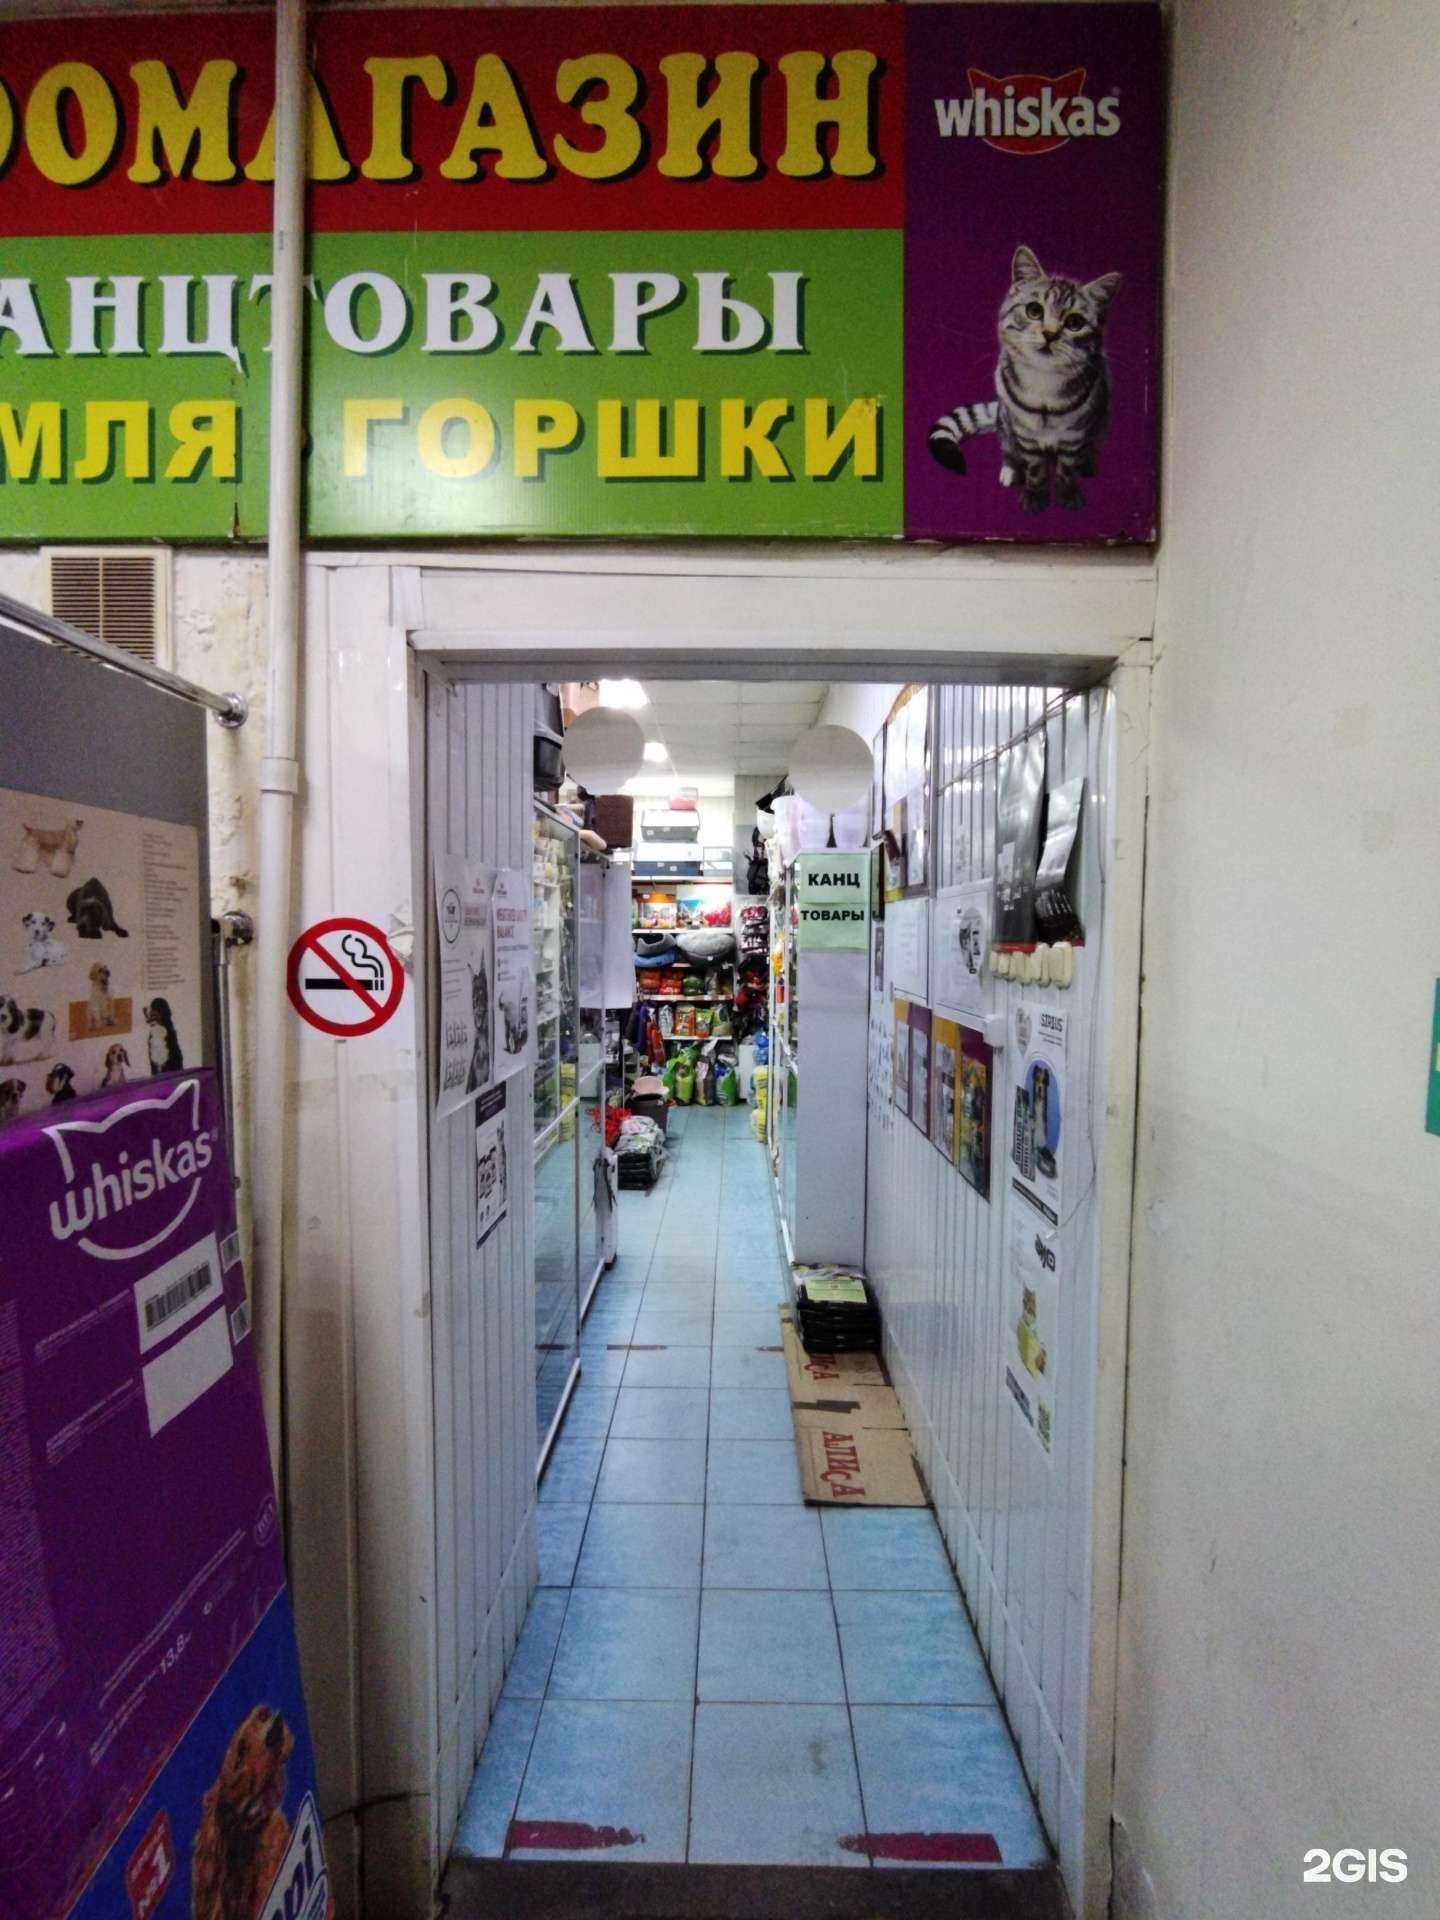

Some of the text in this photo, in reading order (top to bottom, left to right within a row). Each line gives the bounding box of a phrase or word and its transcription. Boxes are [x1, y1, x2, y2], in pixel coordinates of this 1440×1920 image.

[0, 50, 879, 185] ОМАГАЗИН
[933, 84, 1122, 138] whiskas
[0, 398, 880, 479] МЛЯ ГОРШКИ
[808, 872, 861, 889] КАНЦ
[800, 909, 865, 921] ТОВАРЫ
[819, 1431, 867, 1498] АЛИСА
